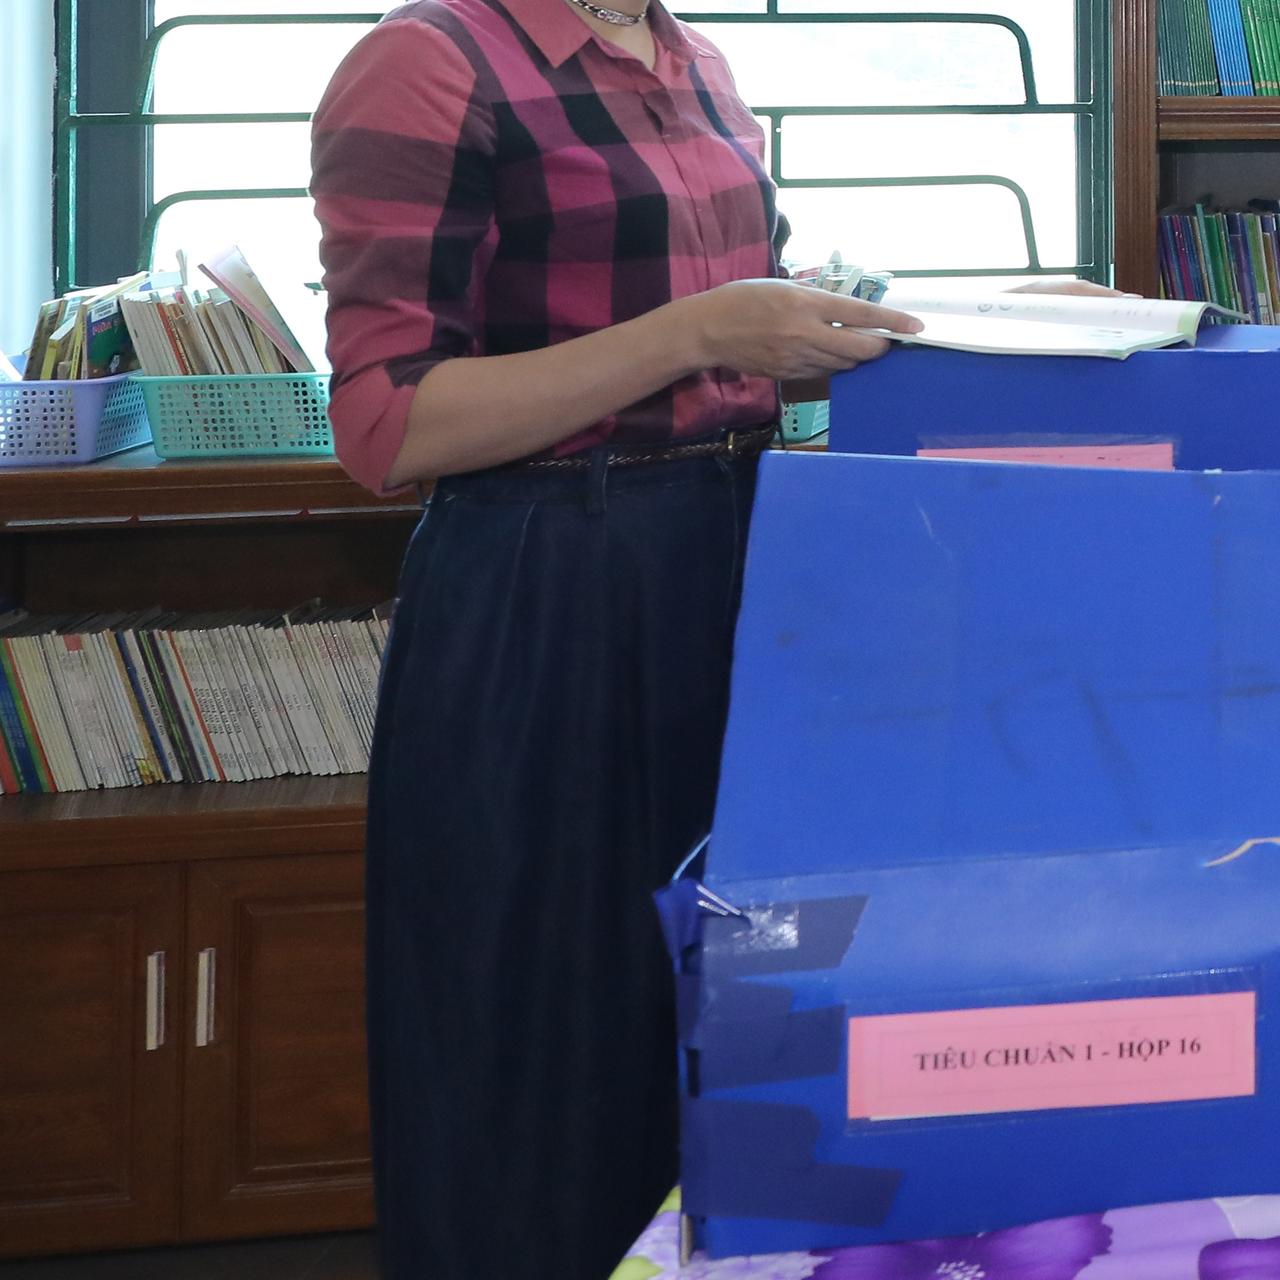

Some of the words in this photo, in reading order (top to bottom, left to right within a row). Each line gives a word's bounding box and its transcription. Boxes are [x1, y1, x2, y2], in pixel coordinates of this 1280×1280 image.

[913, 1046, 976, 1072] TIÊU
[1118, 1037, 1170, 1062] HỘP
[1180, 1037, 1202, 1055] 16
